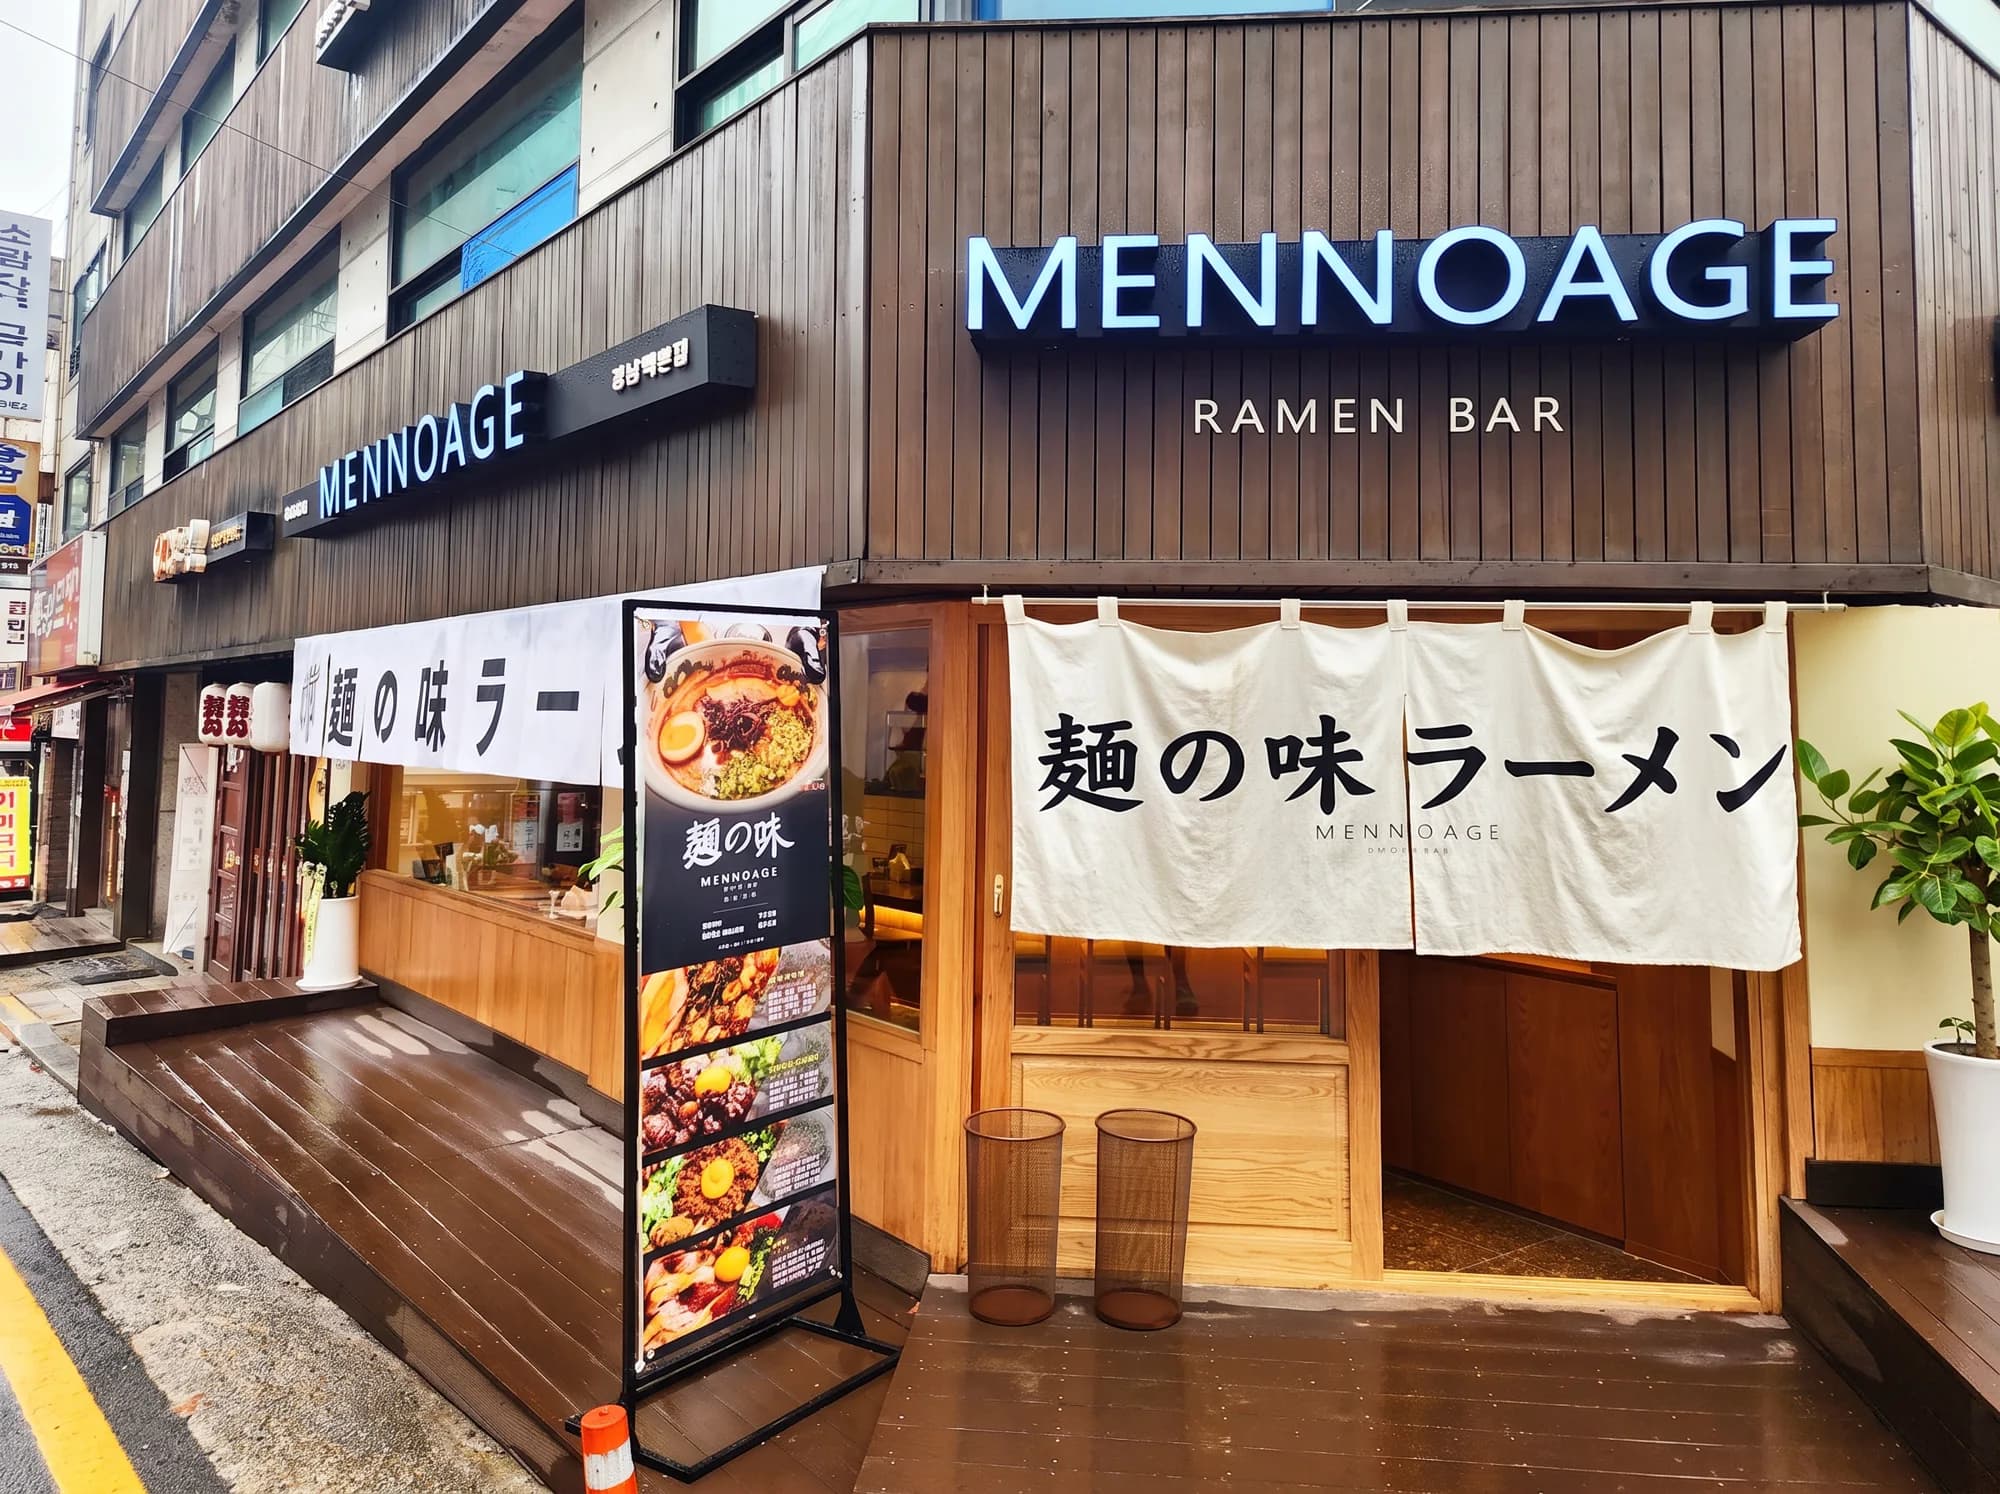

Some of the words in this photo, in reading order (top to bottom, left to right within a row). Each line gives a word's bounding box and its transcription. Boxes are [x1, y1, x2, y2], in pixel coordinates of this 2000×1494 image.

[967, 218, 1840, 330] MENNOAGE
[319, 371, 525, 519] MENNOAGE
[1193, 398, 1405, 434] RAMEN
[1449, 396, 1564, 433] BAR
[328, 657, 624, 766] 麺の味ラー
[1315, 823, 1500, 841] MENNOAGE
[700, 866, 778, 888] MENNOAGE
